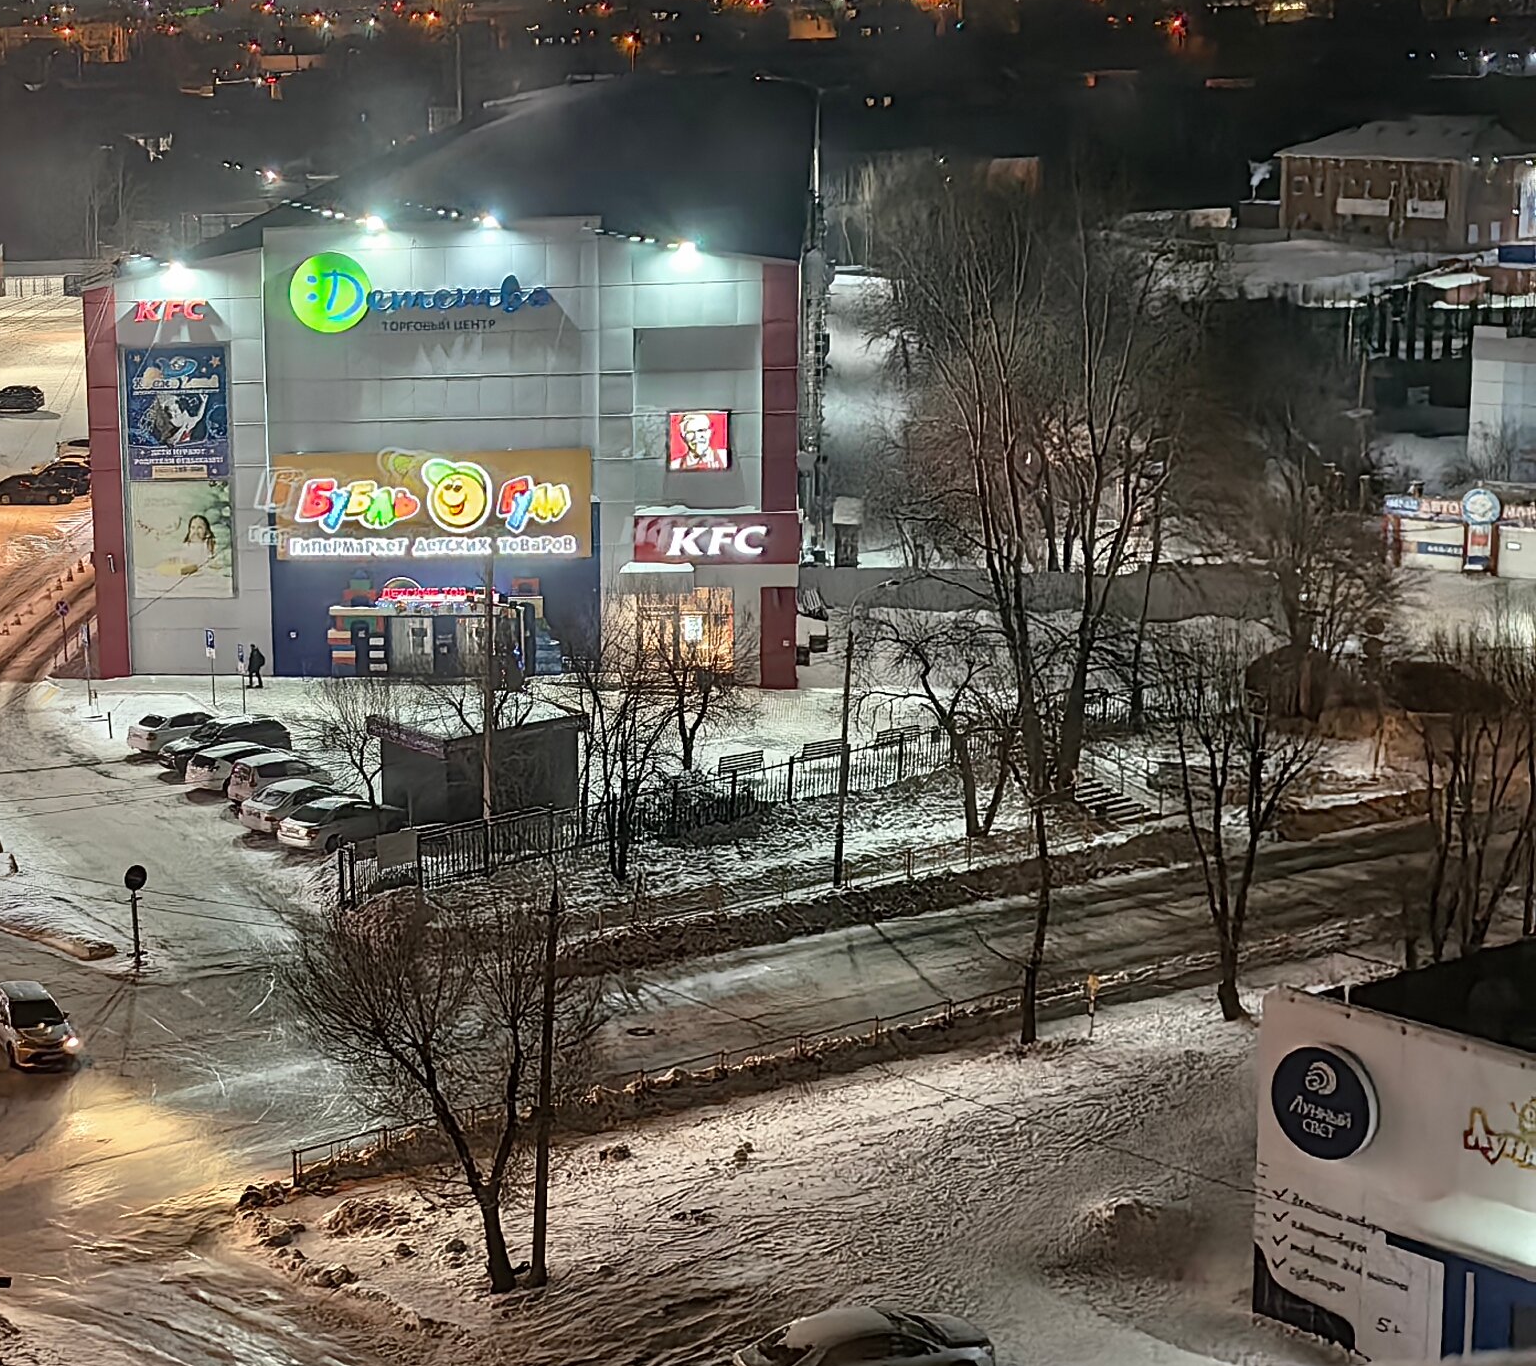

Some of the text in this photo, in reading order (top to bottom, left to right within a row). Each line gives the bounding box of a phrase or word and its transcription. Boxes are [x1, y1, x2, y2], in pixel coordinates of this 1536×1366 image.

[135, 300, 206, 322] KFC
[381, 318, 496, 332] ТОРГОВЫЙ ЦЕНТР
[498, 478, 570, 531] ГУМ
[666, 525, 768, 556] KFC
